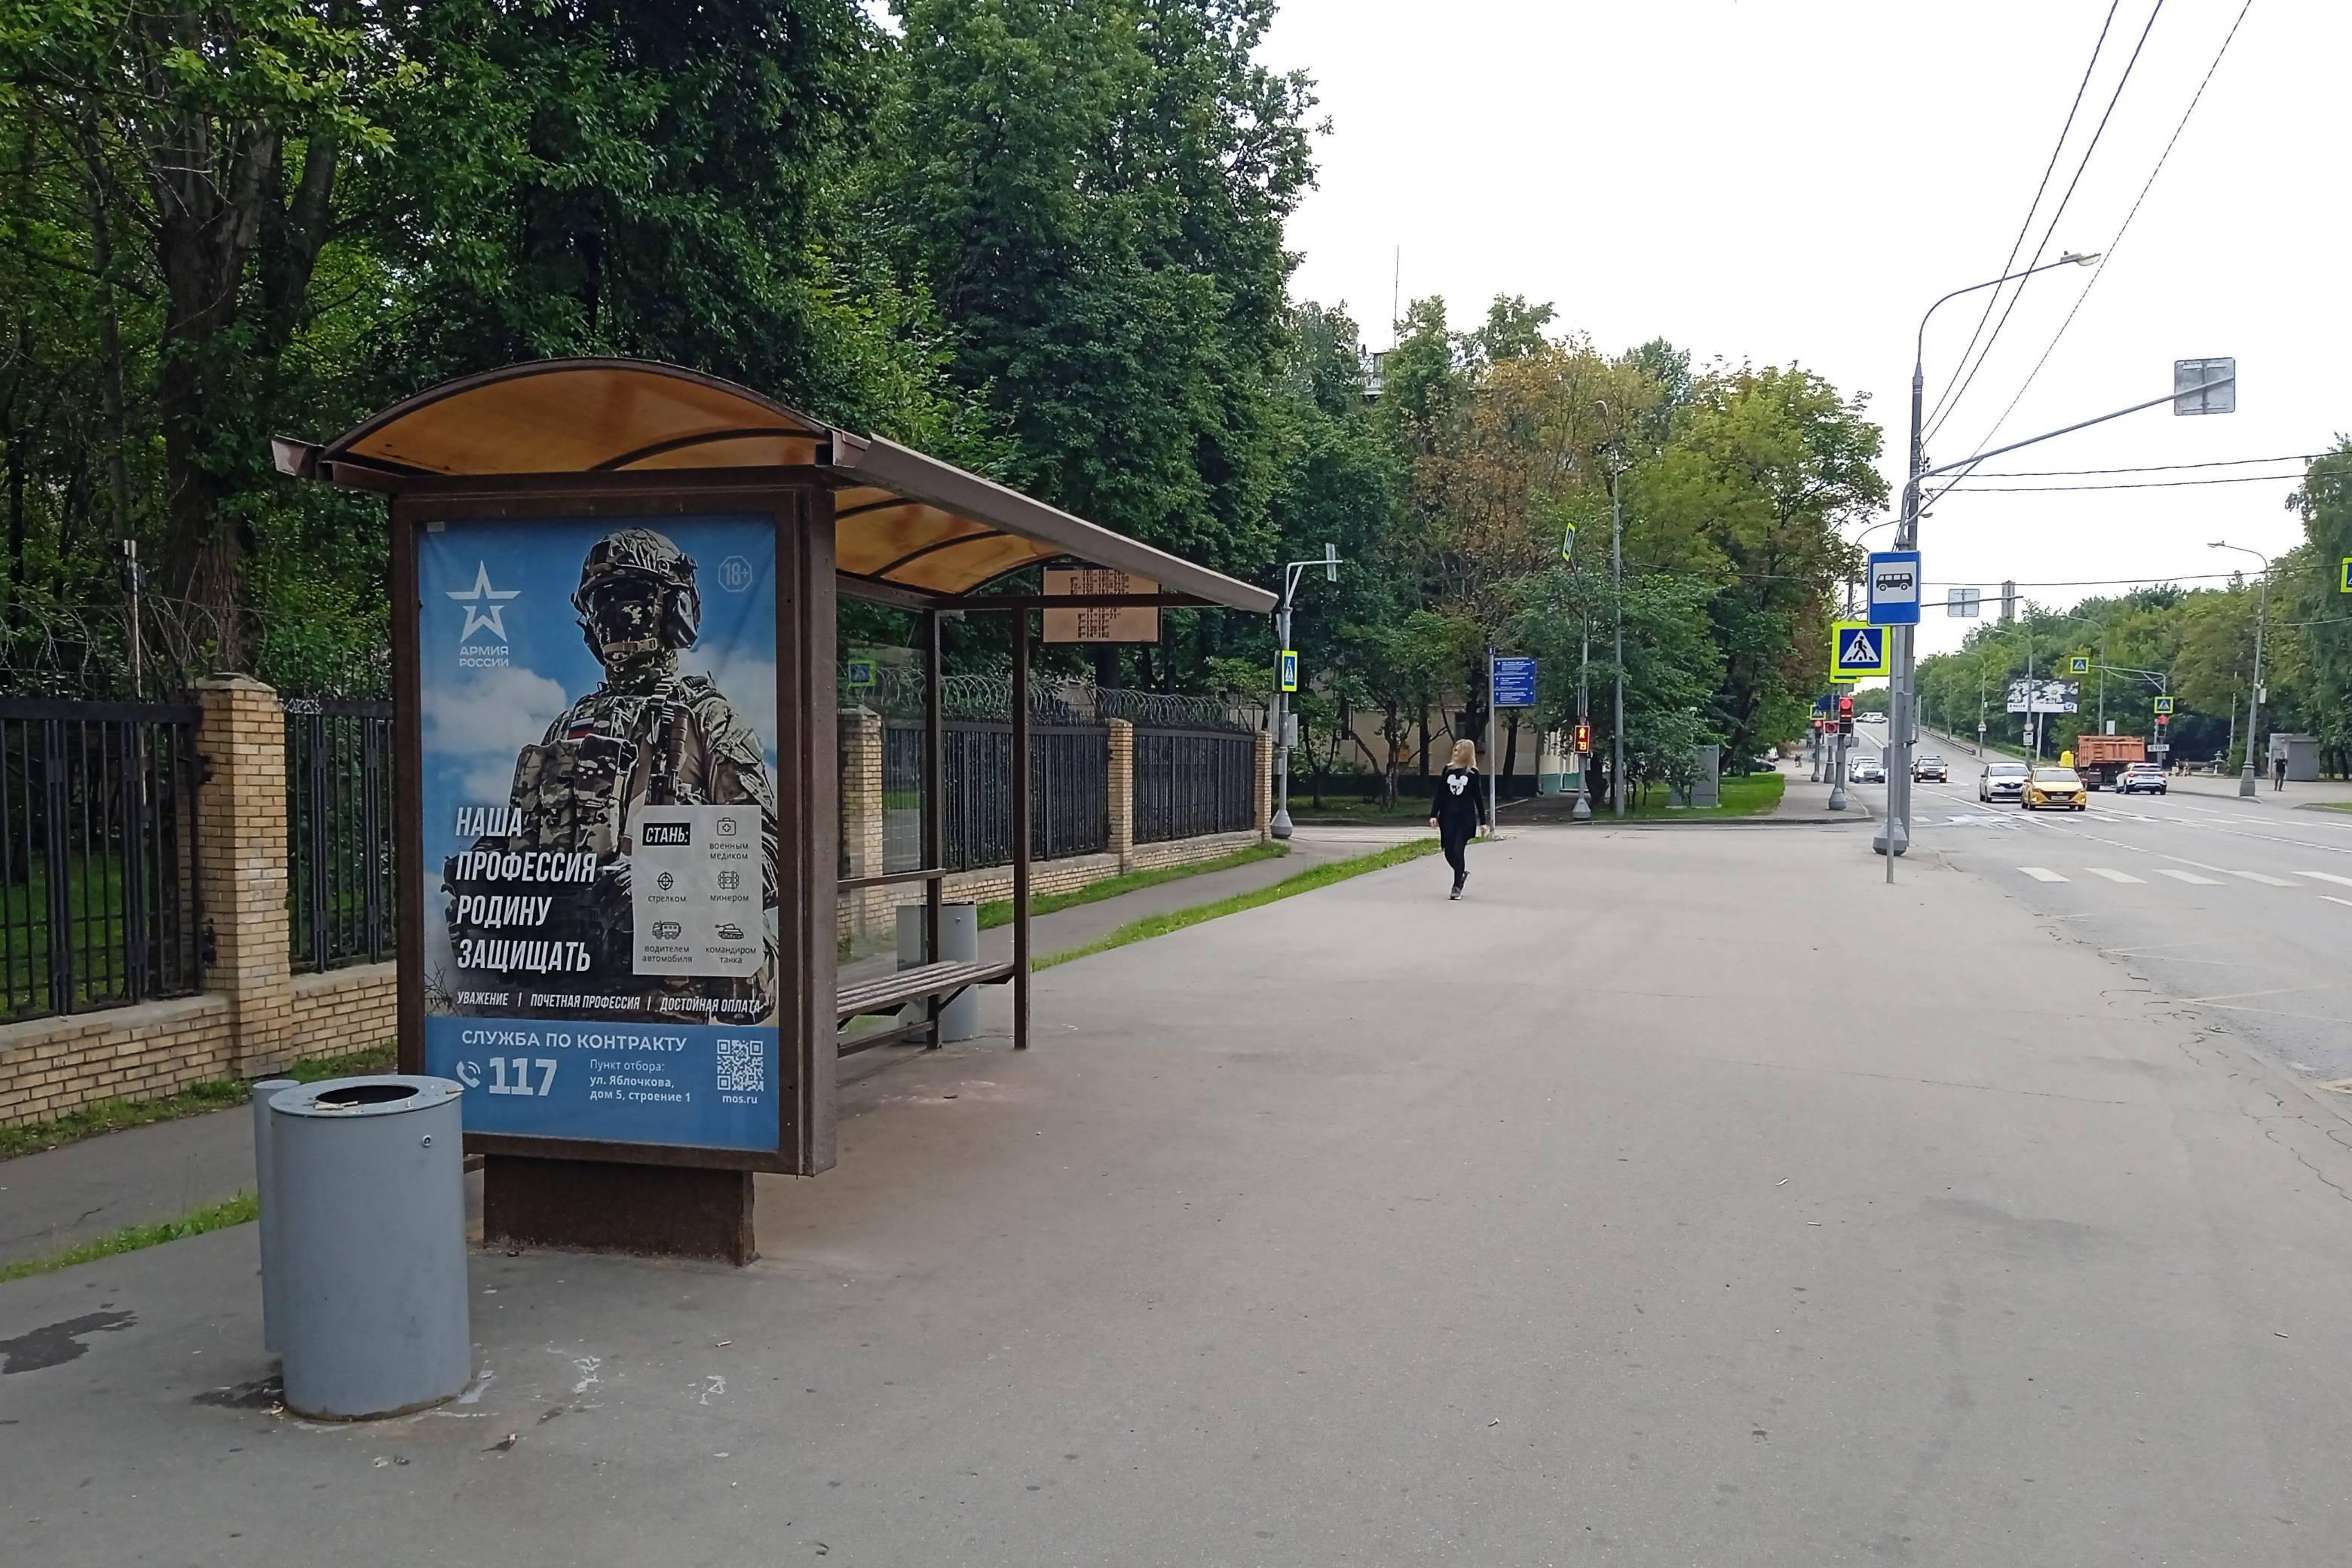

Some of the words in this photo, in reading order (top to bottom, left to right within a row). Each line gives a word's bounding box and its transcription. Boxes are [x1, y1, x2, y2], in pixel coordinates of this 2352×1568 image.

[724, 562, 749, 586] 18+
[459, 646, 509, 656] АРМИЯ
[459, 658, 509, 667] РОССИИ
[455, 807, 522, 837] НАША
[645, 827, 689, 843] СТАНЬ:
[455, 851, 597, 882] ПРОФЕССИЯ
[648, 895, 686, 903] стрелком
[710, 894, 749, 903] минером
[456, 896, 553, 929] РОДИНУ
[457, 939, 591, 974] ЗАЩИЩАТЬ
[645, 945, 690, 954] водителем
[642, 954, 692, 963] автомобиля
[457, 991, 509, 1006] УВАЖЕНИЕ
[531, 994, 580, 1008] ПОЧЕТНАЯ
[582, 995, 640, 1010] ПРОФЕССИЯ
[660, 996, 718, 1012] ДОСТОЙНАЯ
[721, 999, 760, 1013] ОПЛАТА
[462, 1030, 541, 1046] СЛУЖБА
[546, 1033, 571, 1048] ПО
[577, 1034, 687, 1052] КОНТРАКТУ
[590, 1059, 620, 1073] Пункт
[624, 1060, 665, 1073] отбора:
[489, 1057, 557, 1096] 117
[590, 1076, 606, 1087] ул.
[609, 1076, 675, 1089] Яблочкова,
[590, 1091, 613, 1101] дом
[616, 1090, 626, 1101] 5,
[629, 1092, 681, 1103] строение
[685, 1092, 691, 1102] 1
[722, 1095, 758, 1104] mos.ru
